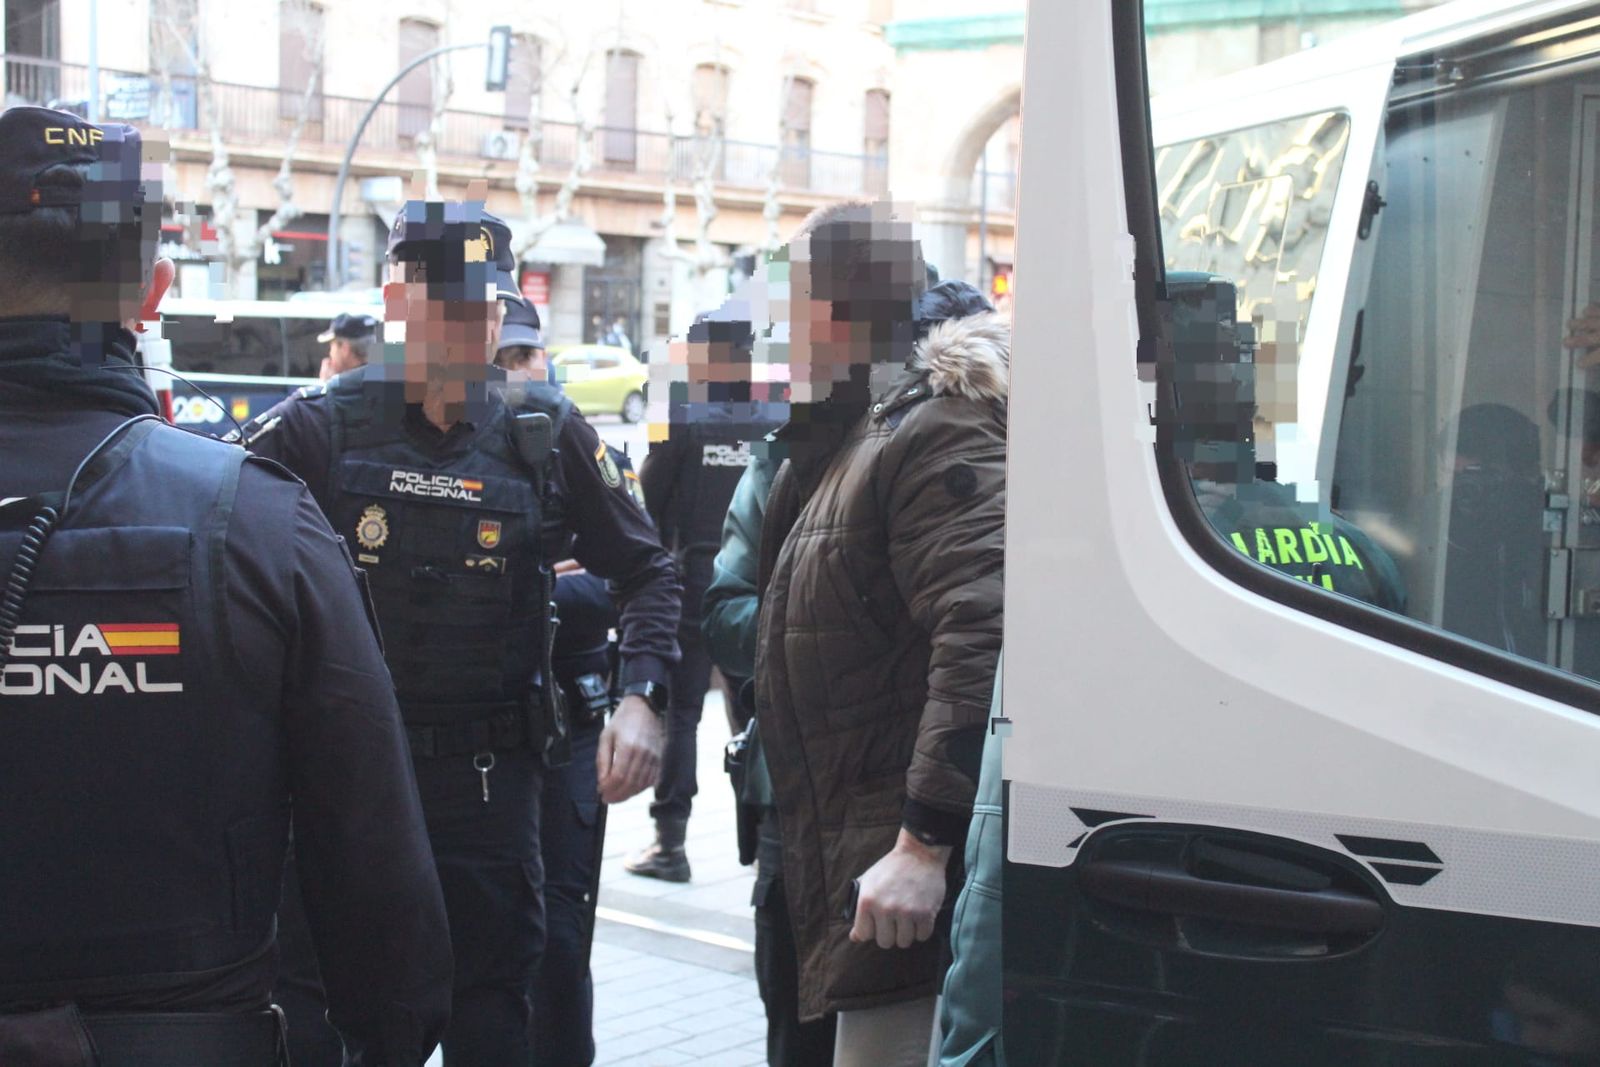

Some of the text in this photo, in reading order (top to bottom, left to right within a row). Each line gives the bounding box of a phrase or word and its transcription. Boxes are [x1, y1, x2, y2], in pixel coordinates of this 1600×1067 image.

[391, 470, 464, 489] POLICIA
[389, 481, 481, 502] NACIONAL
[0, 662, 183, 695] ONAL
